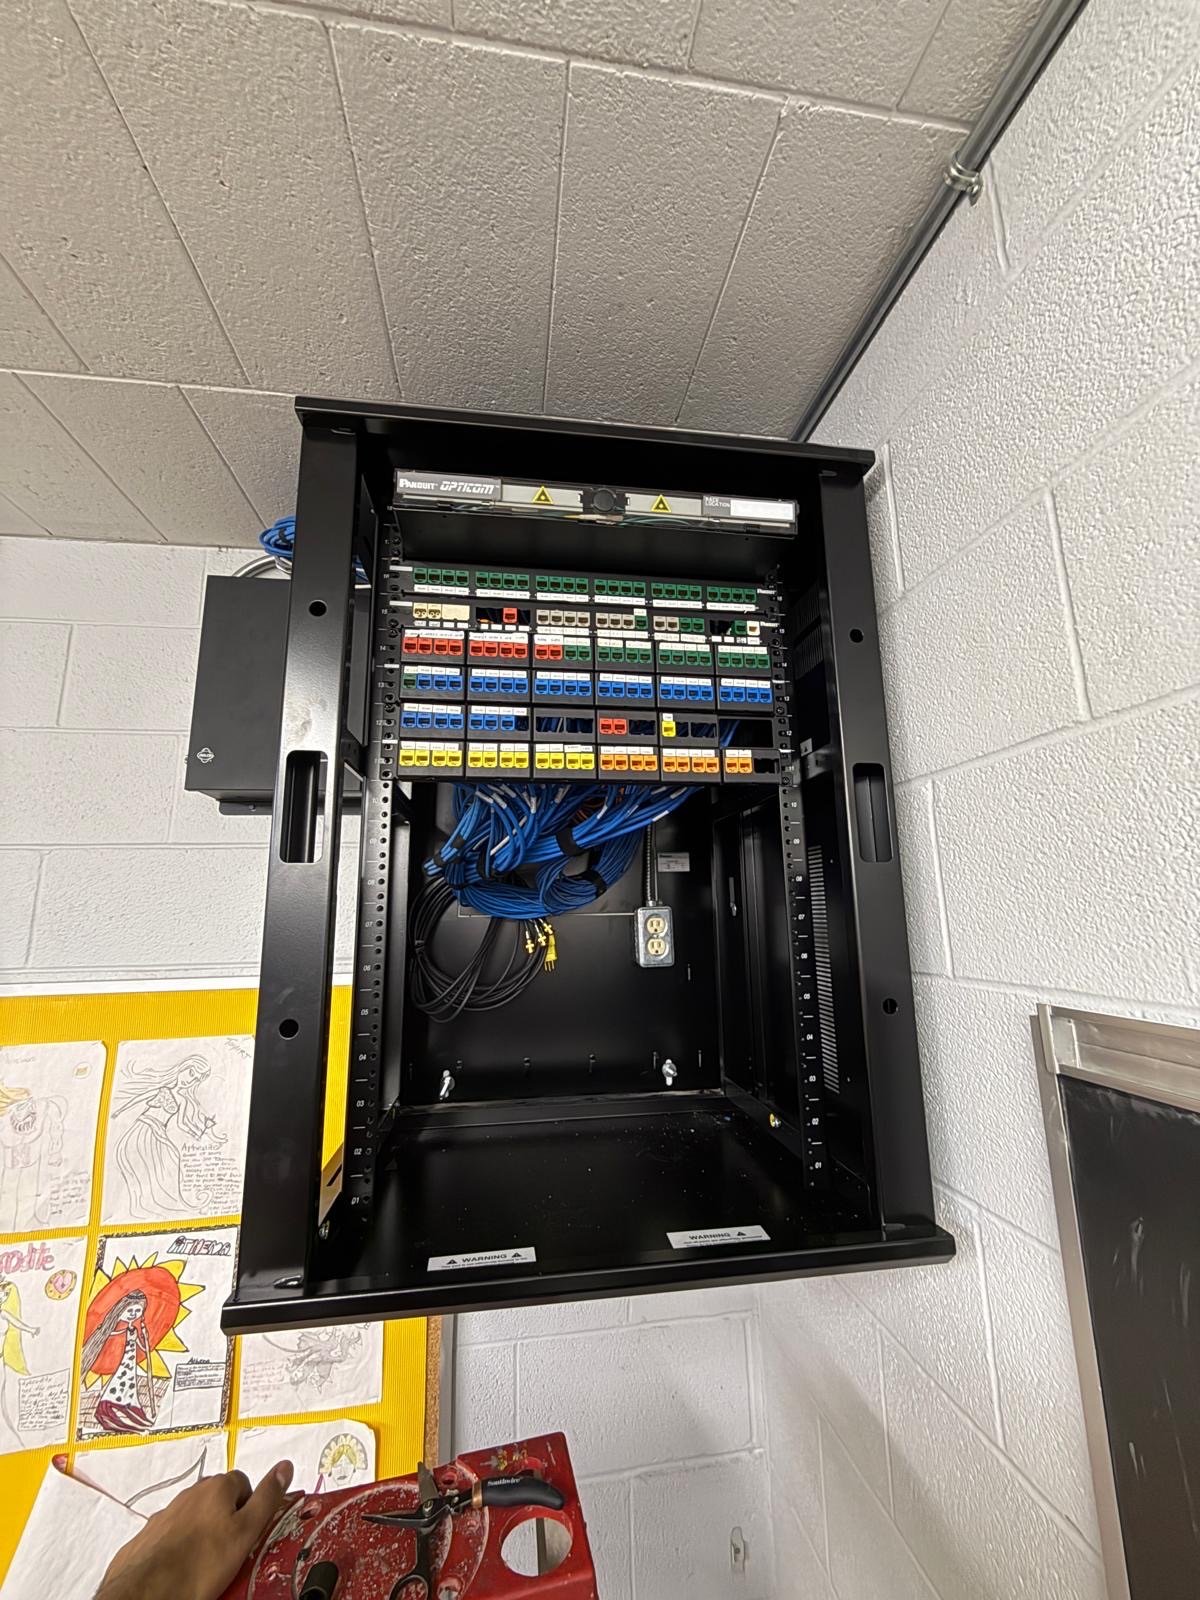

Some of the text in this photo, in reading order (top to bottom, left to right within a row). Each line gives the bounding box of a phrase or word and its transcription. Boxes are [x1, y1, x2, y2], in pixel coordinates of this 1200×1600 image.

[358, 1053, 367, 1061] 04
[689, 1232, 731, 1241] WARNING
[462, 1254, 507, 1263] WARNING
